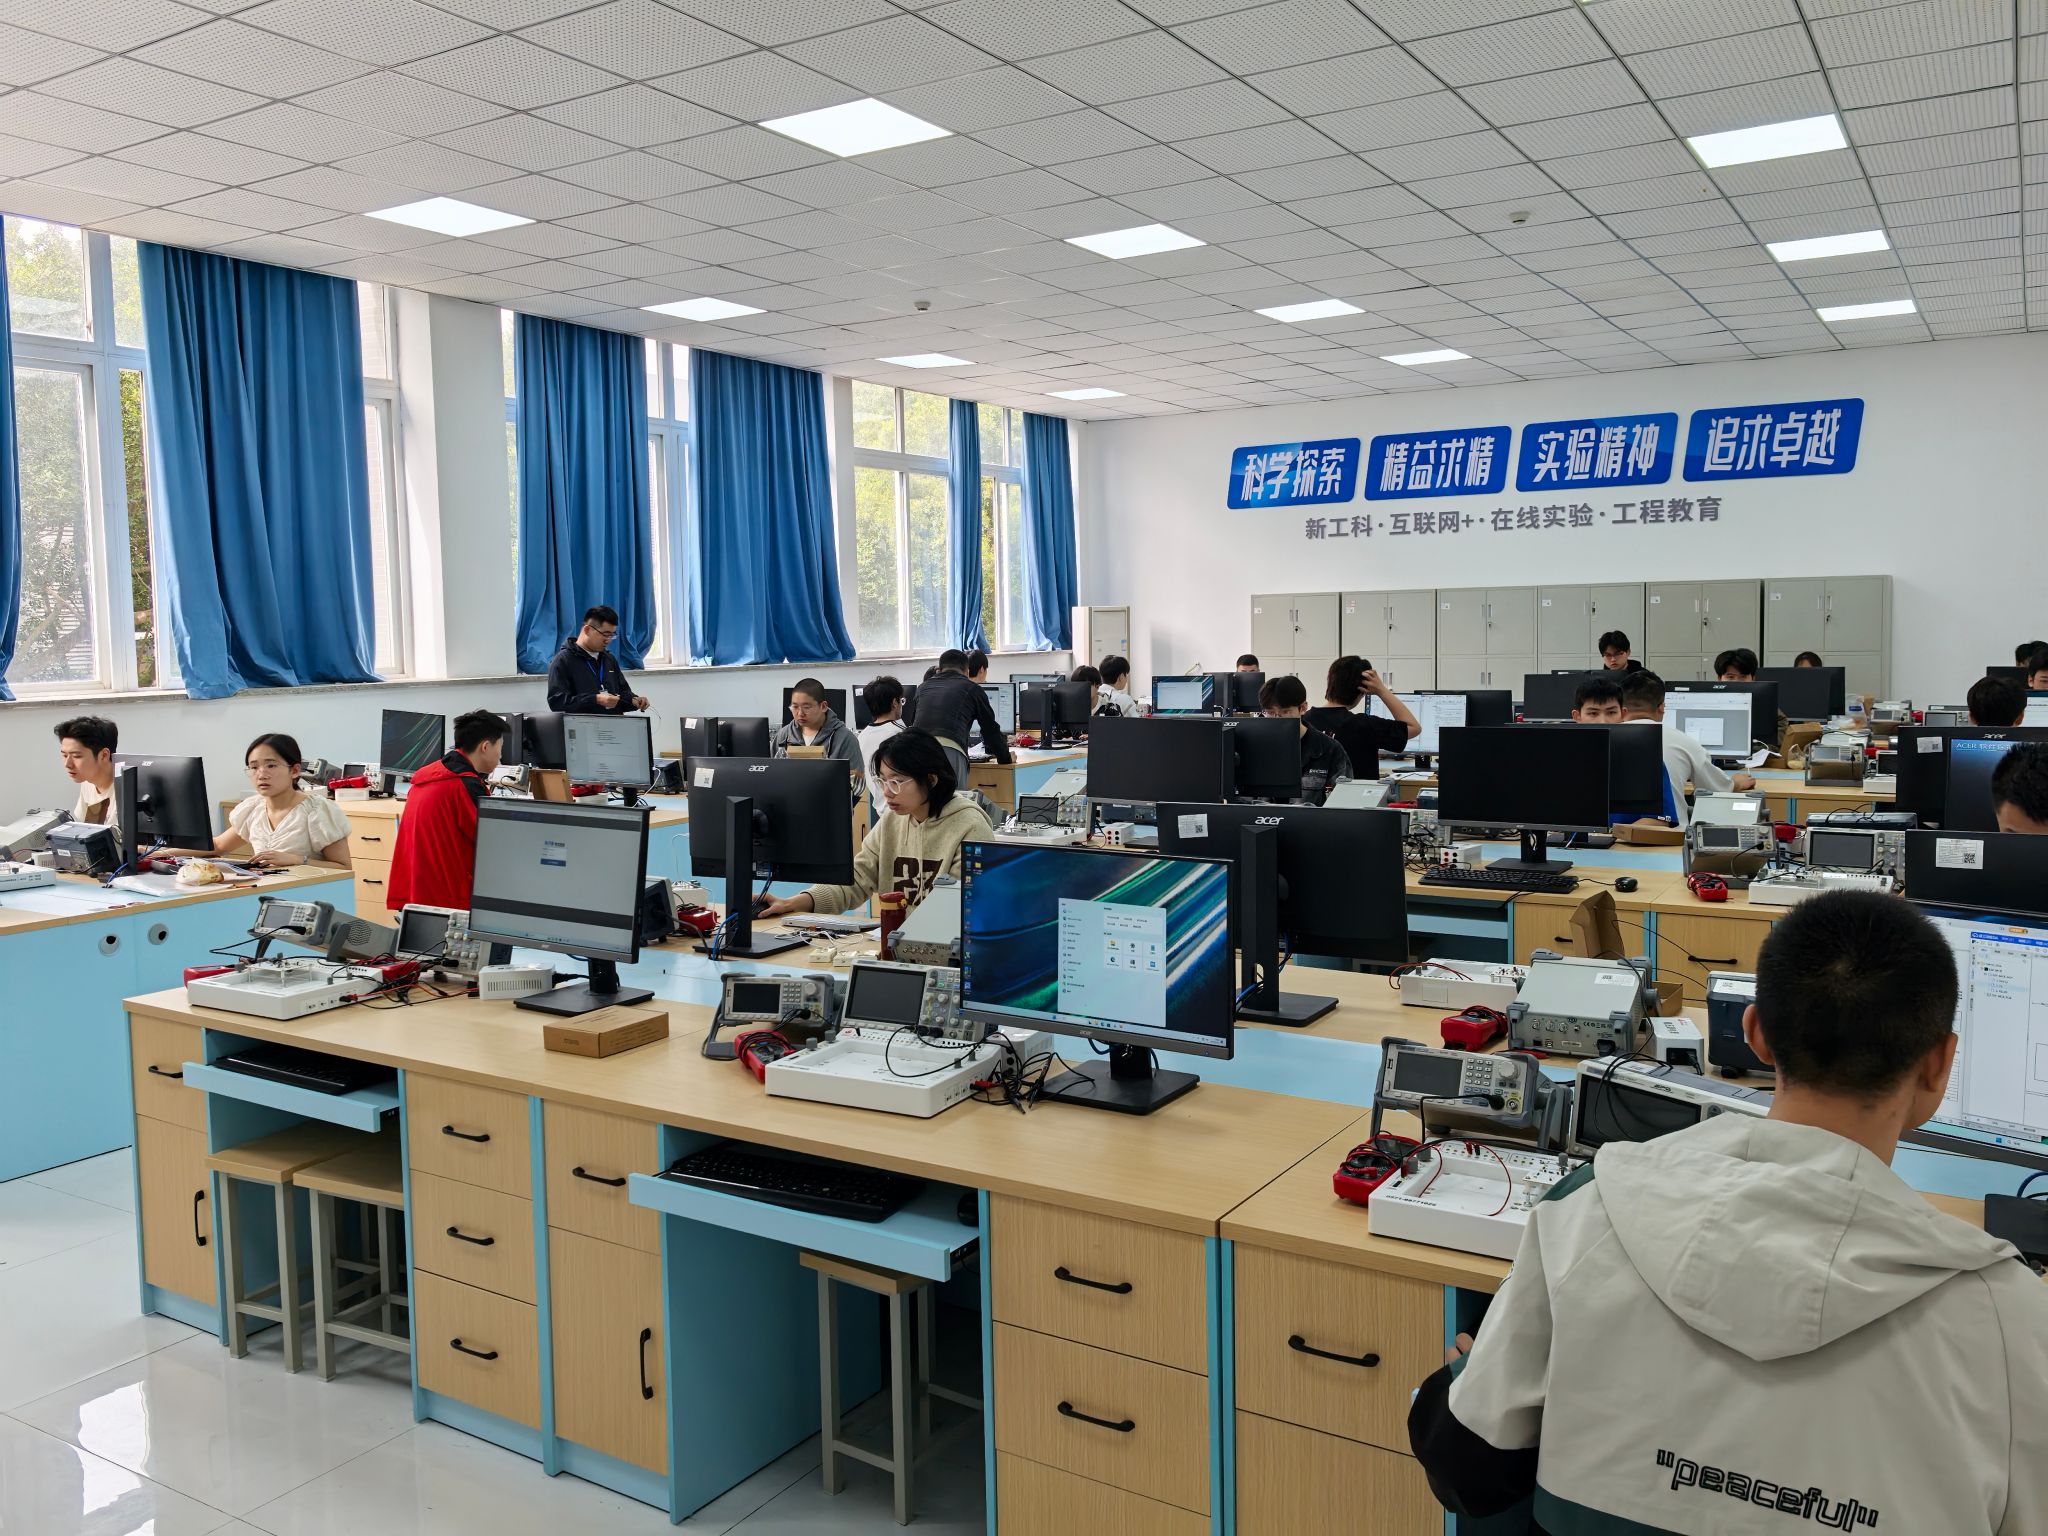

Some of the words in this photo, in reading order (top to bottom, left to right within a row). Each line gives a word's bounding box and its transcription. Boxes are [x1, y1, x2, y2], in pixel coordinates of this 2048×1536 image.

[1379, 435, 1496, 492] 精益求精
[1531, 422, 1660, 482] 实验精神
[1703, 408, 1842, 473] 追求卓越
[1240, 447, 1347, 501] 科学探索
[1254, 816, 1285, 826] acer
